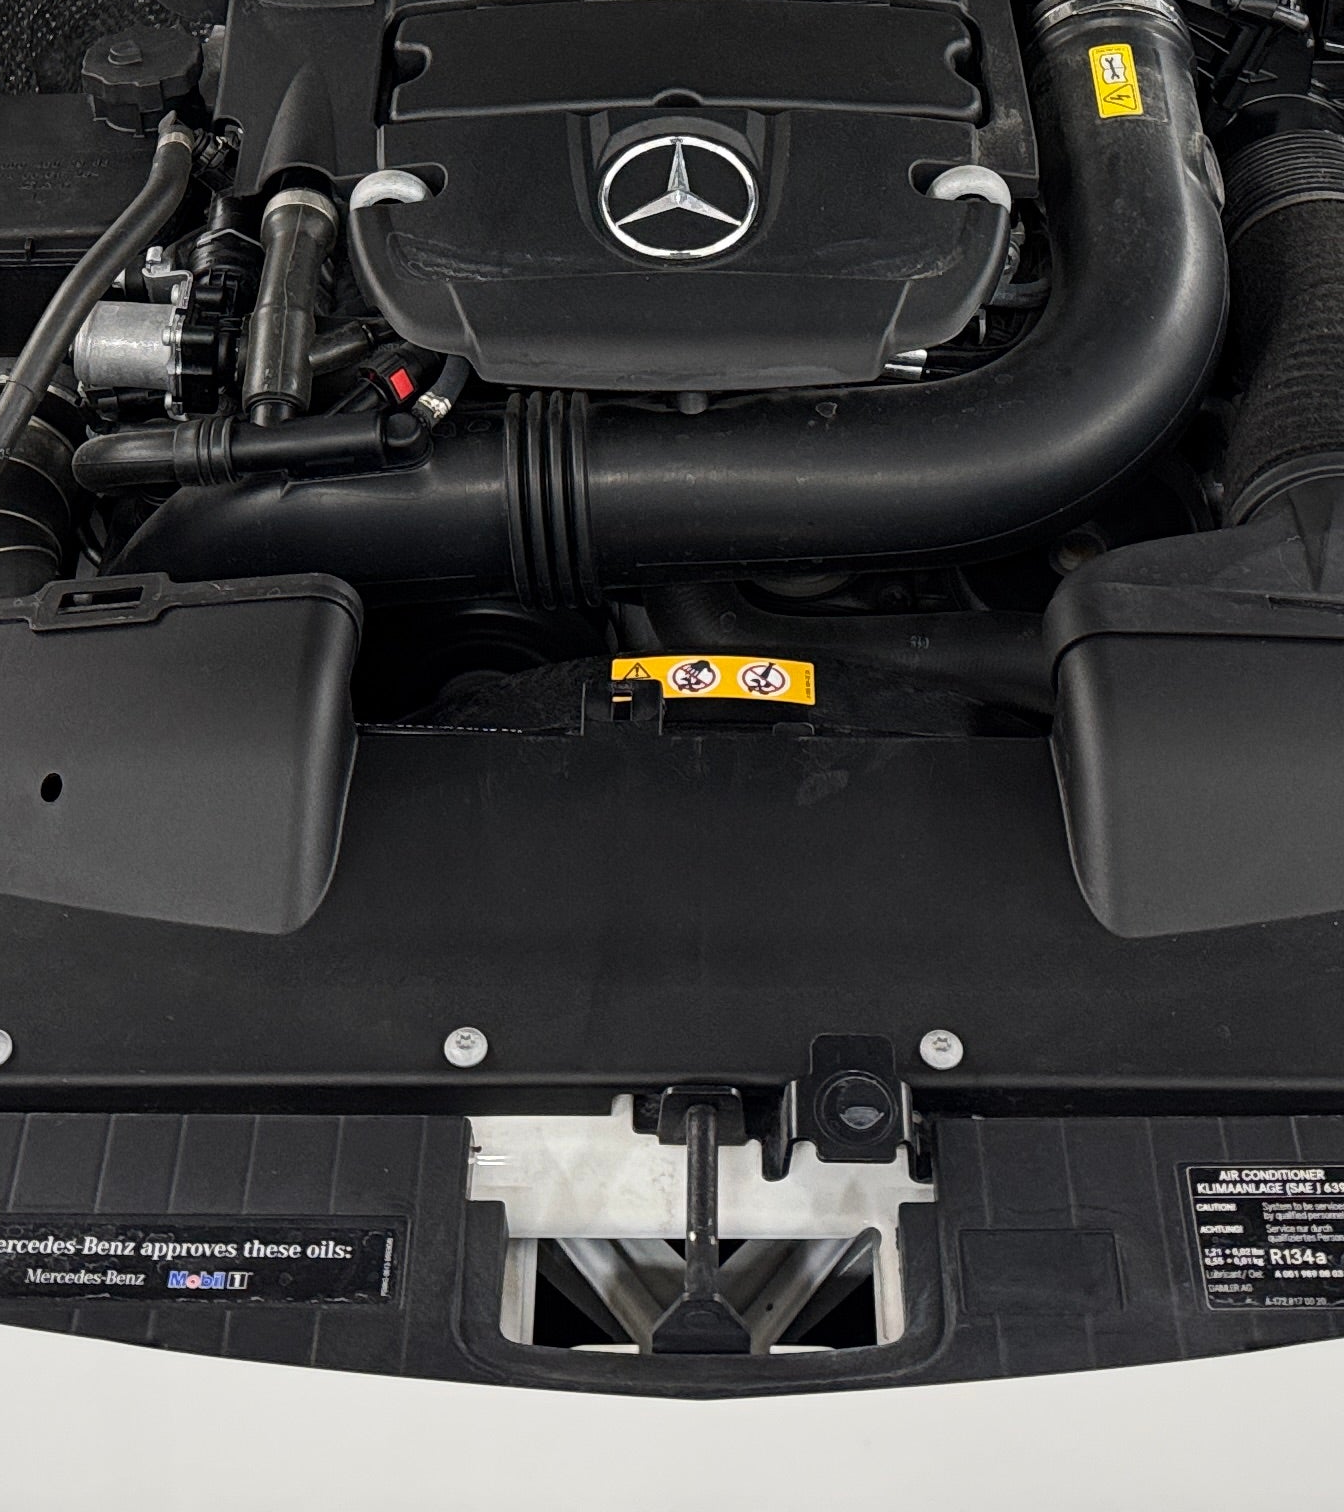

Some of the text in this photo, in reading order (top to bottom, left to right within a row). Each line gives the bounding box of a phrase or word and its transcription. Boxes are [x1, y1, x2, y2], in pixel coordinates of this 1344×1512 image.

[1218, 1169, 1326, 1181] AIR CONDITIONER
[1196, 1183, 1285, 1195] KLIMAANLAGE
[1286, 1183, 1314, 1196] (SAE
[1262, 1201, 1293, 1212] System
[1293, 1202, 1302, 1211] to
[1302, 1202, 1314, 1211] be
[1263, 1211, 1275, 1221] by
[1275, 1211, 1307, 1221] qualified
[1266, 1224, 1296, 1234] Service
[1310, 1224, 1333, 1234] durch
[140, 1238, 238, 1261] approves
[243, 1239, 301, 1259] these
[306, 1240, 354, 1260] oils:
[1269, 1248, 1329, 1265] R134a
[25, 1267, 146, 1287] Mercedes-Benz
[167, 1270, 225, 1289] Mobil
[1274, 1269, 1282, 1278] A
[1241, 1284, 1254, 1293] AG
